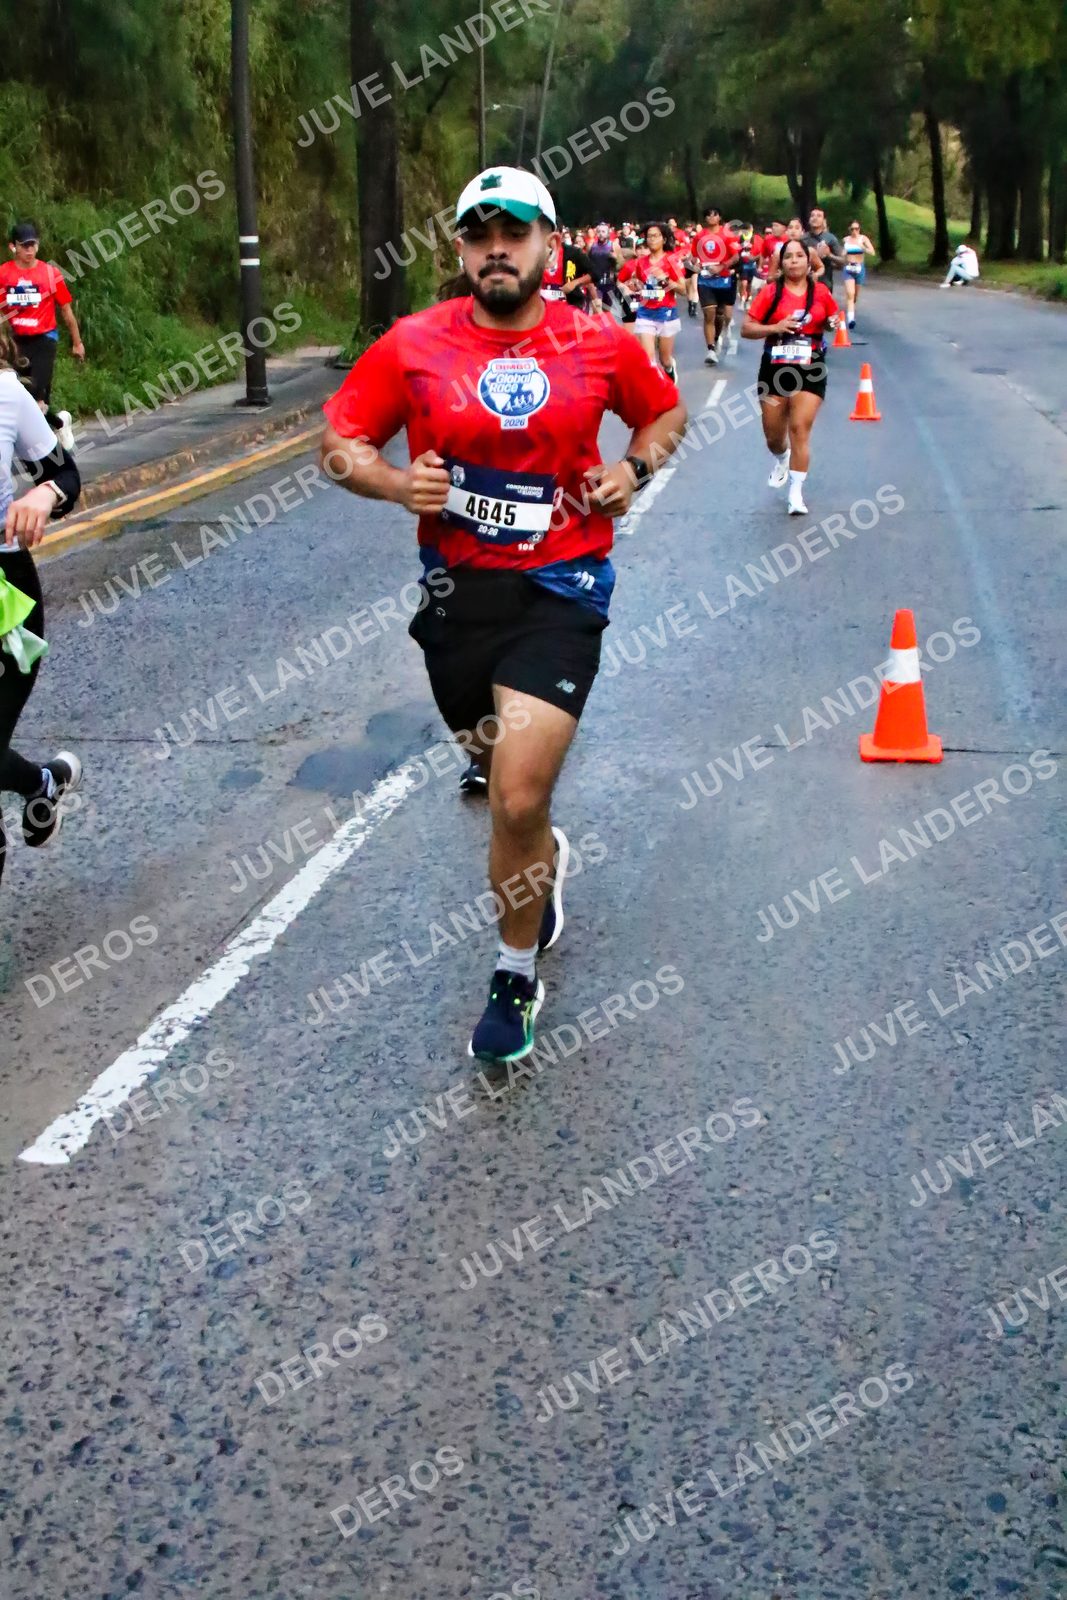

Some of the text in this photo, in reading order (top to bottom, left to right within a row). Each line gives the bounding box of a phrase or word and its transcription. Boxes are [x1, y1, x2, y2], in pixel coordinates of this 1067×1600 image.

[496, 373, 531, 384] Global
[491, 383, 518, 393] Race
[504, 419, 526, 428] 2026
[465, 495, 517, 526] 4645
